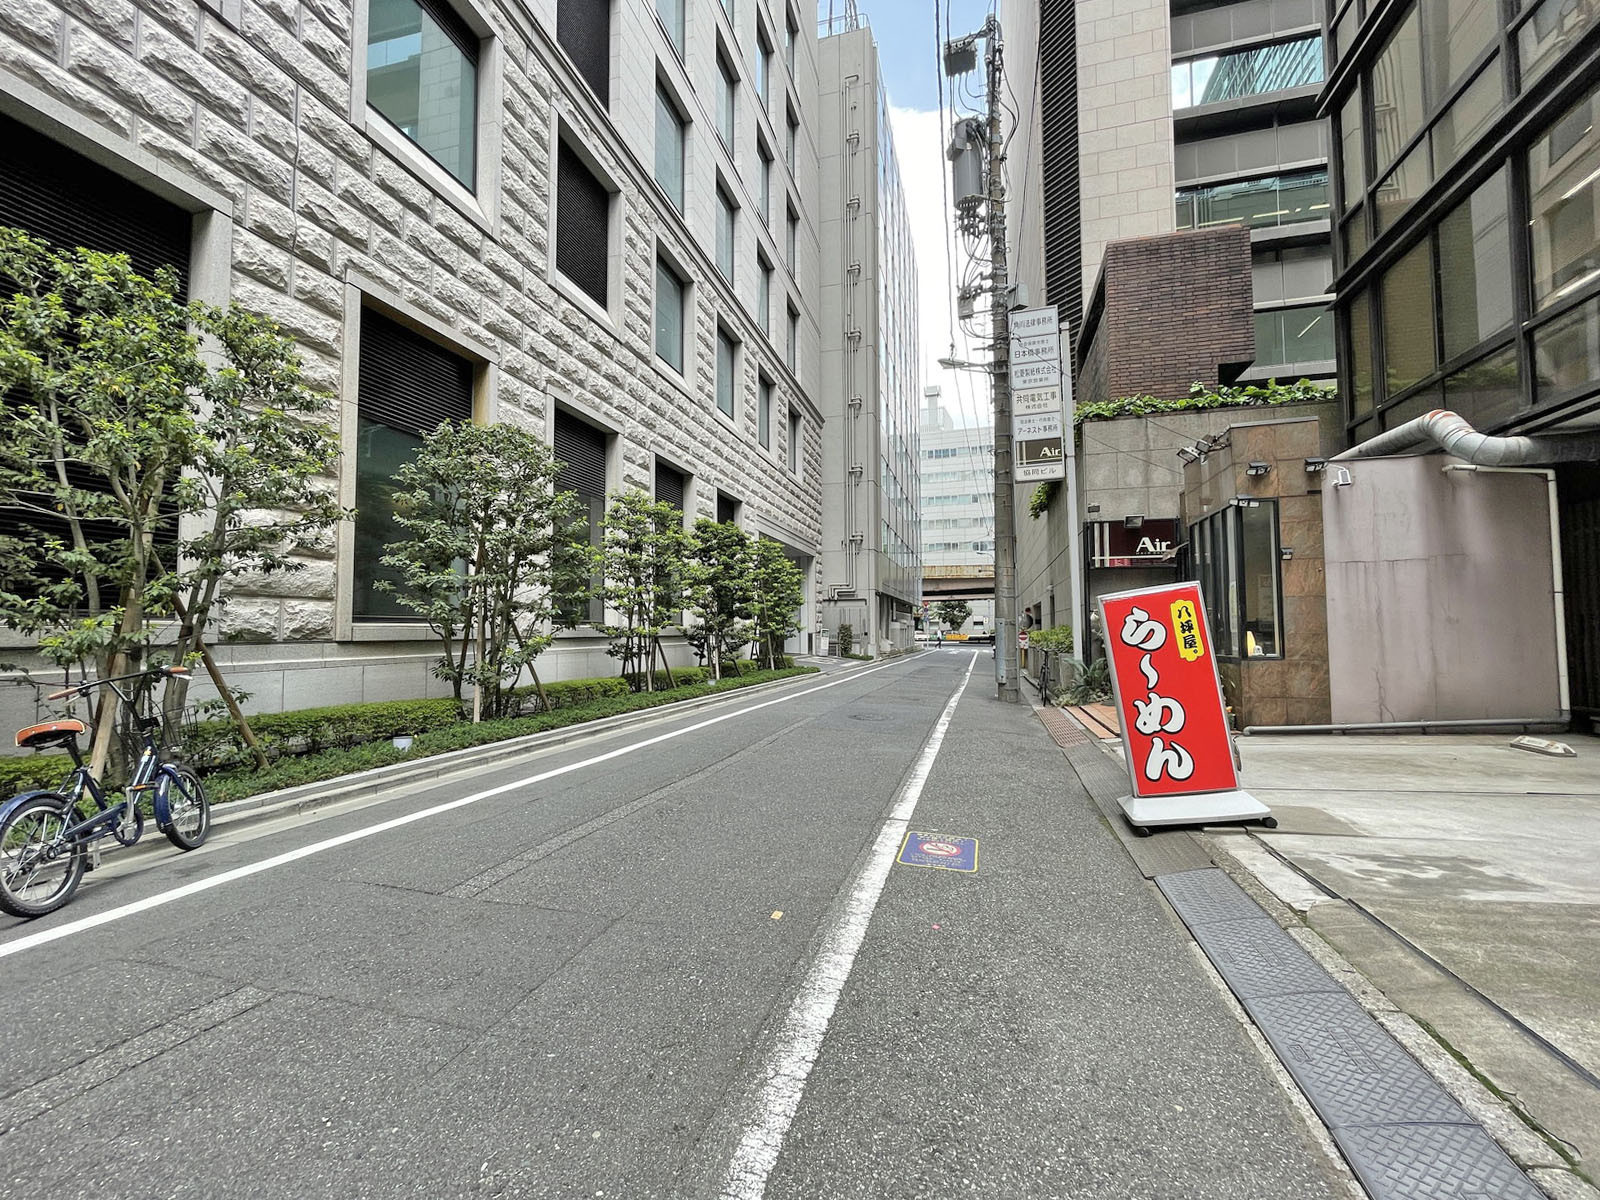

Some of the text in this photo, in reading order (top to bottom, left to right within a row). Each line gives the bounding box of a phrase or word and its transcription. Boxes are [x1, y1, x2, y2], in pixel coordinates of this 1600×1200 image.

[1016, 391, 1056, 404] 共同電気工事
[1039, 446, 1061, 458] Air
[1136, 536, 1171, 553] Air
